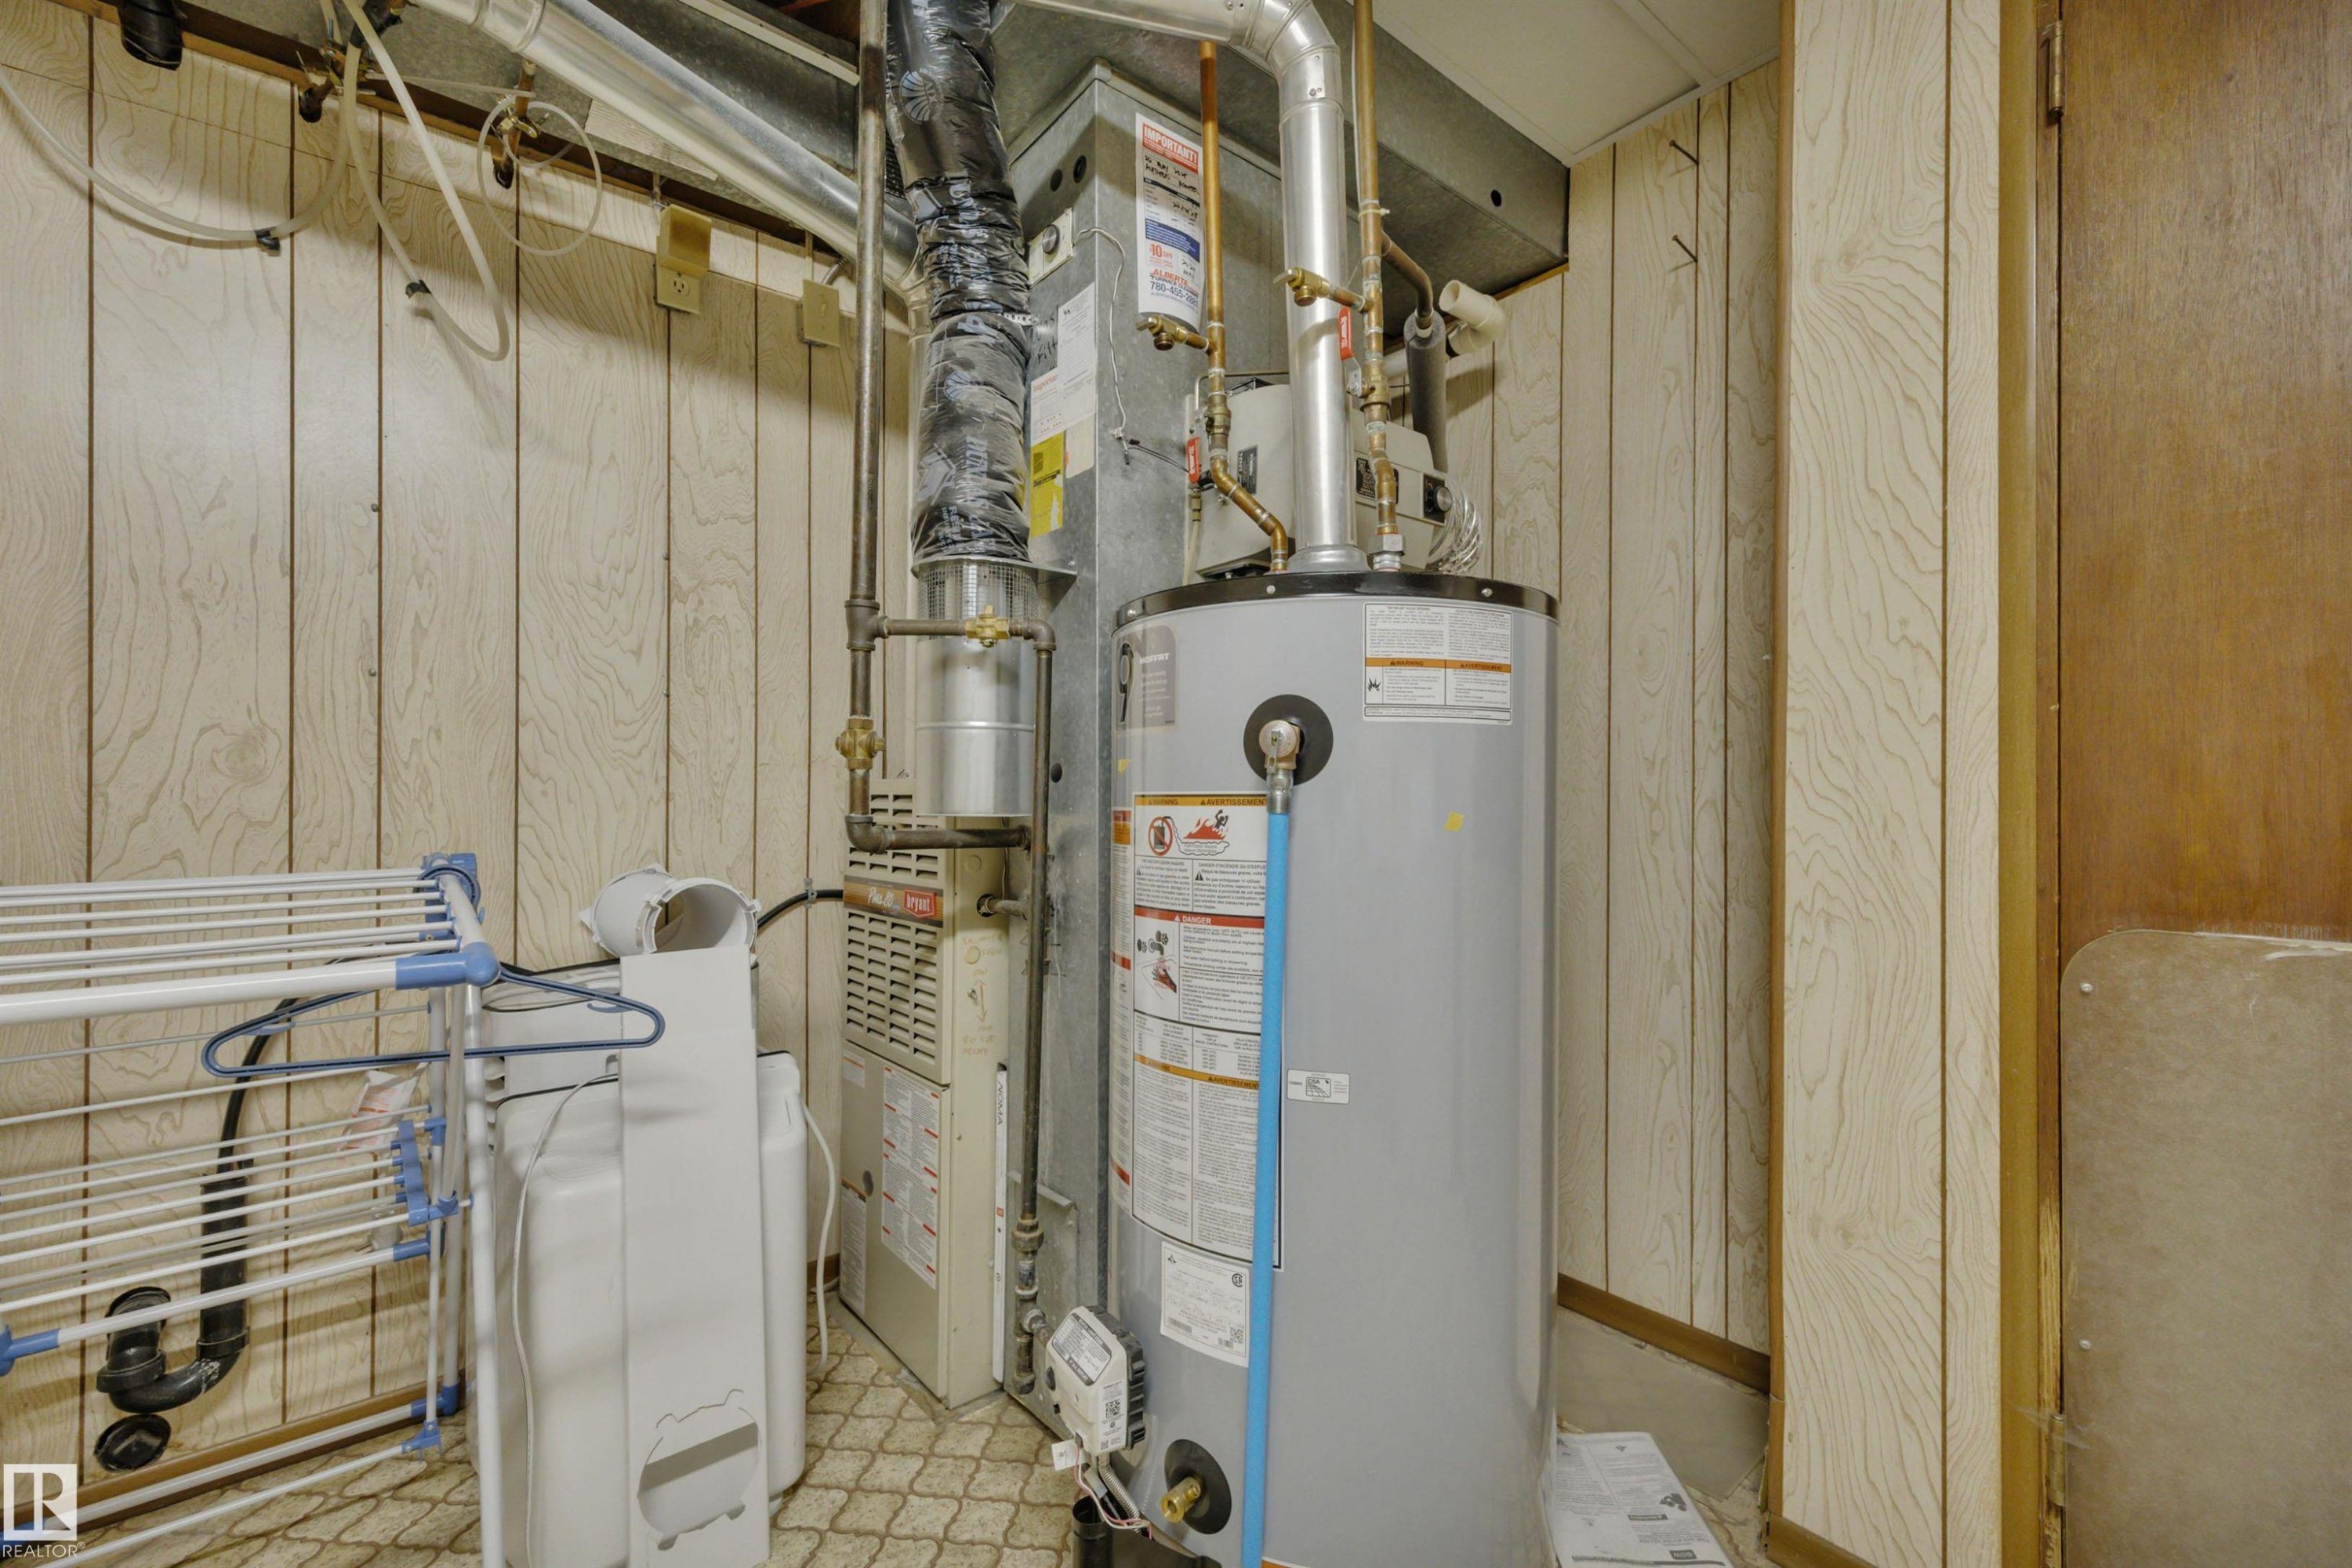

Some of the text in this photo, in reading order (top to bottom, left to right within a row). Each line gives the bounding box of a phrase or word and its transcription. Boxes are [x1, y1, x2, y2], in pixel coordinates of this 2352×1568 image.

[1144, 125, 1197, 163] IMPORTANT!
[1152, 268, 1189, 285] ALBERTA
[1139, 652, 1170, 664] MOFFAT
[1465, 663, 1503, 672] AVERTISSEMENT
[906, 893, 931, 913] bryant
[1182, 916, 1211, 924] DANGER
